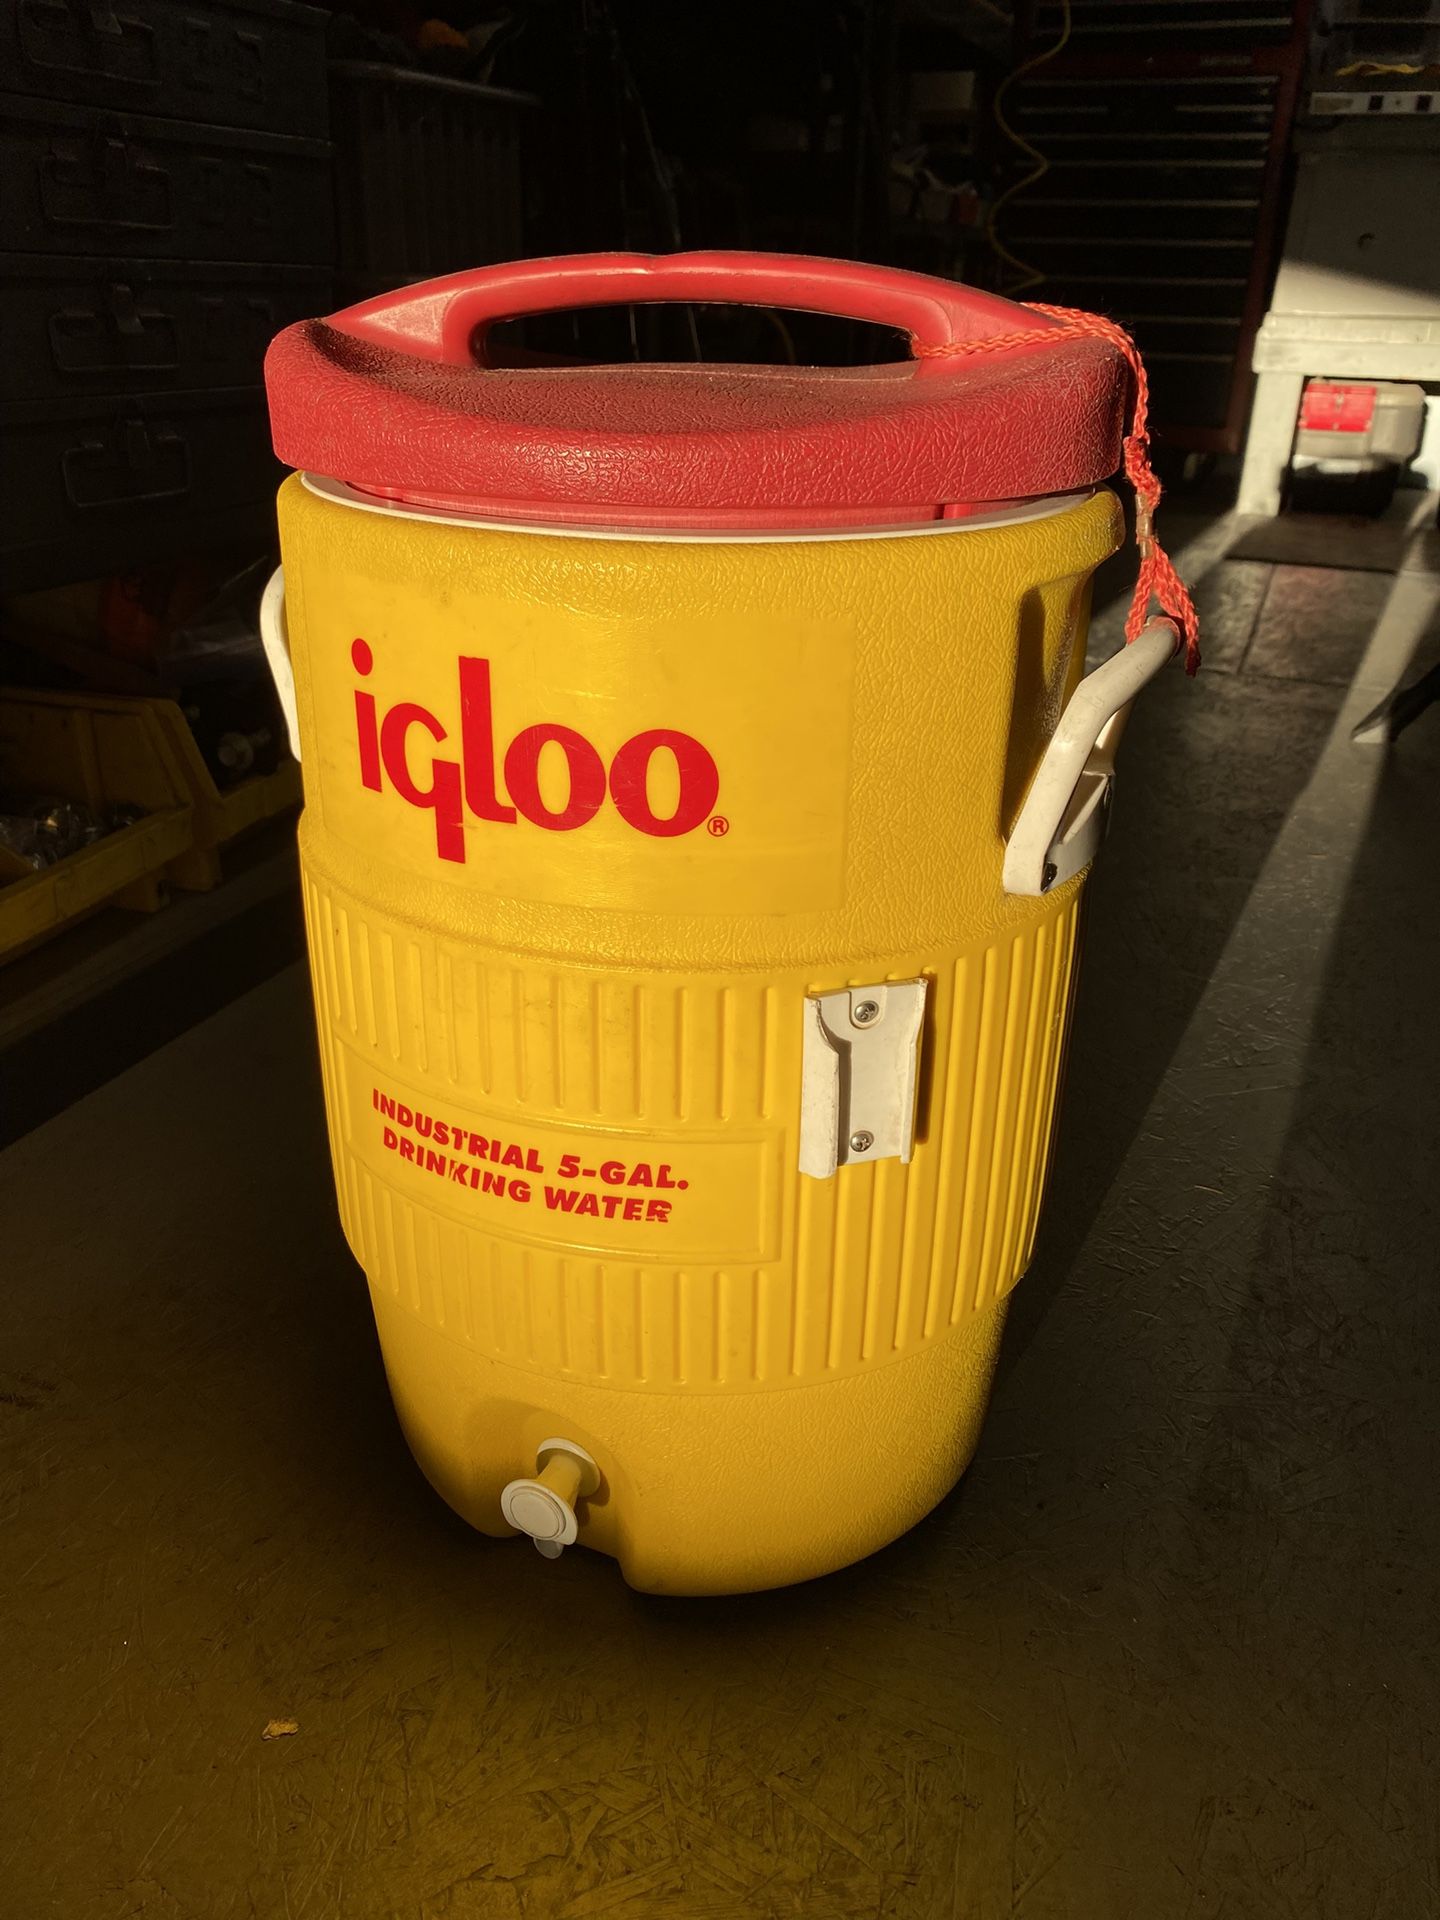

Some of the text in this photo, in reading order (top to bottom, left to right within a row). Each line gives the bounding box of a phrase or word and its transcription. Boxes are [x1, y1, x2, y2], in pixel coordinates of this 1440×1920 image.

[372, 1088, 689, 1190] INDUSTRIAL 5-GAL.
[383, 1126, 673, 1224] DRINKING WATER
